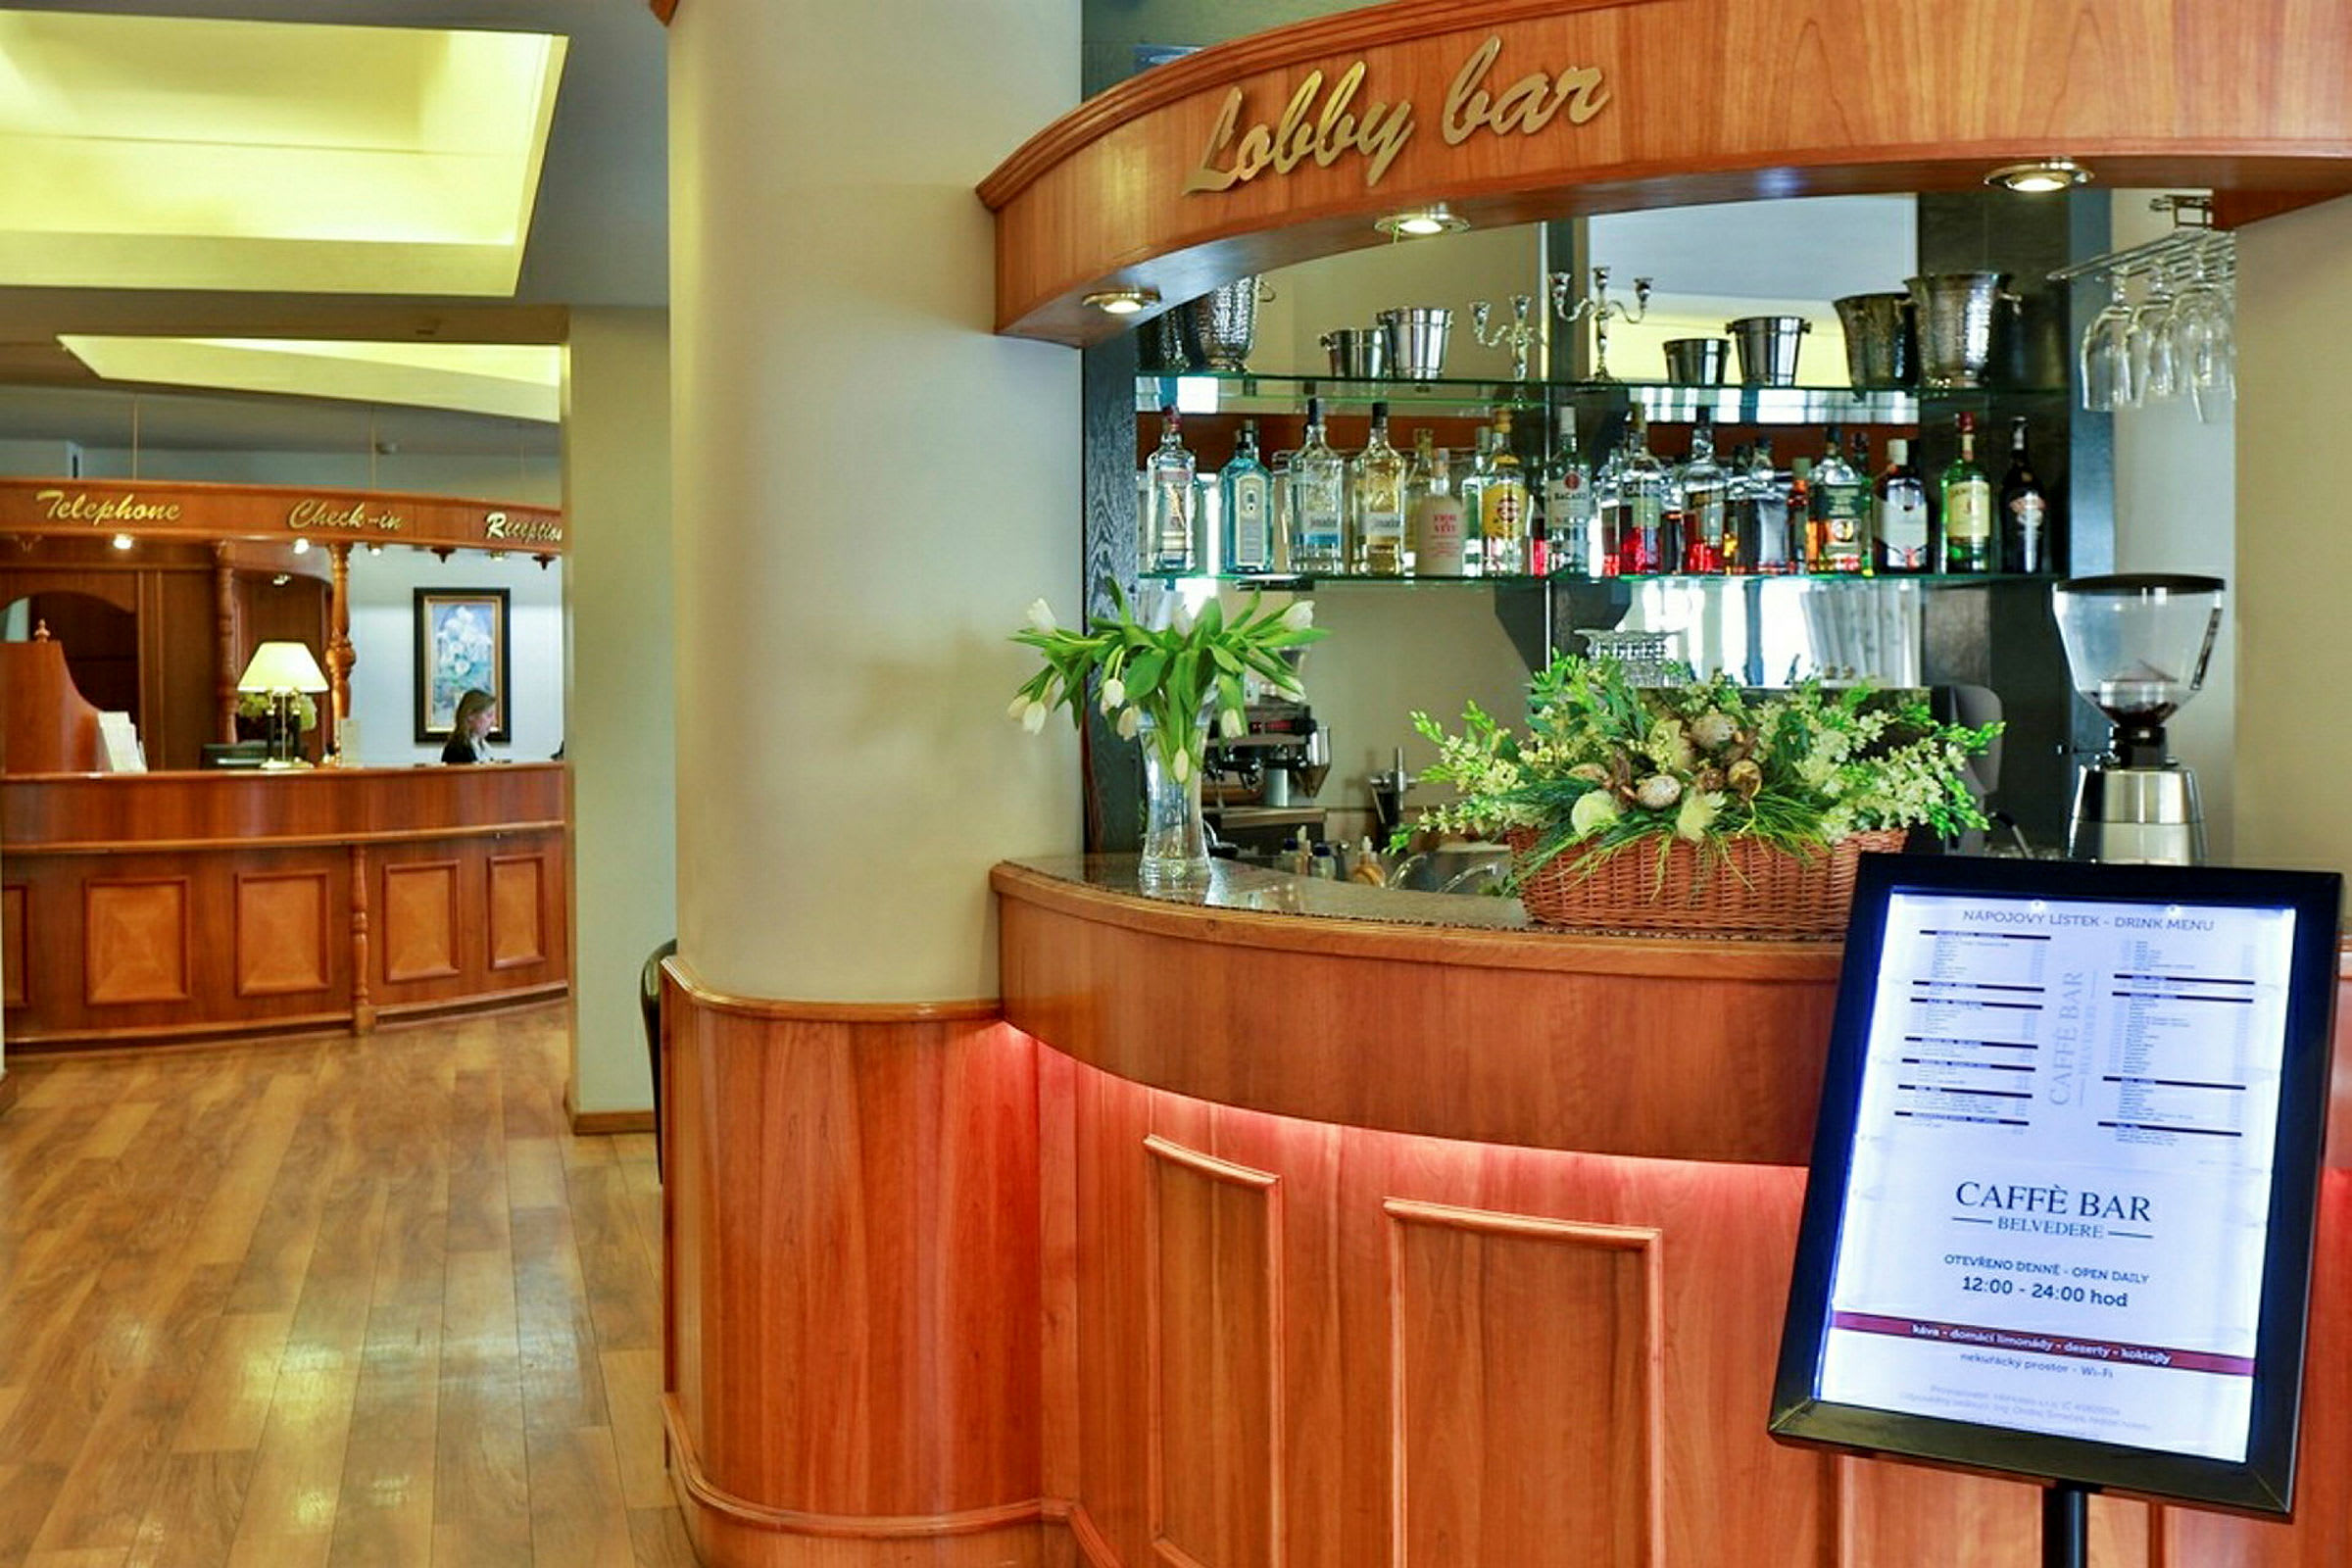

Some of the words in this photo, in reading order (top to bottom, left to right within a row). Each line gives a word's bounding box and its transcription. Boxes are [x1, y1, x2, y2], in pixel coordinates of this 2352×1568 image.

[1182, 60, 1415, 196] Lobby
[1442, 34, 1610, 146] bar
[36, 489, 180, 526] Telephone
[289, 498, 403, 529] Check-in
[2114, 916, 2163, 929] DRINK
[2166, 918, 2215, 932] MENU
[1956, 1182, 2069, 1215] CAFFÈ
[2079, 1192, 2151, 1222] BAR
[1997, 1216, 2105, 1239] BELVEDERE
[2071, 1266, 2108, 1281] OPEN
[2111, 1270, 2150, 1285] DAILY
[1963, 1276, 2014, 1295] 12:00
[2032, 1283, 2085, 1302] 24:00
[2090, 1289, 2129, 1307] hod
